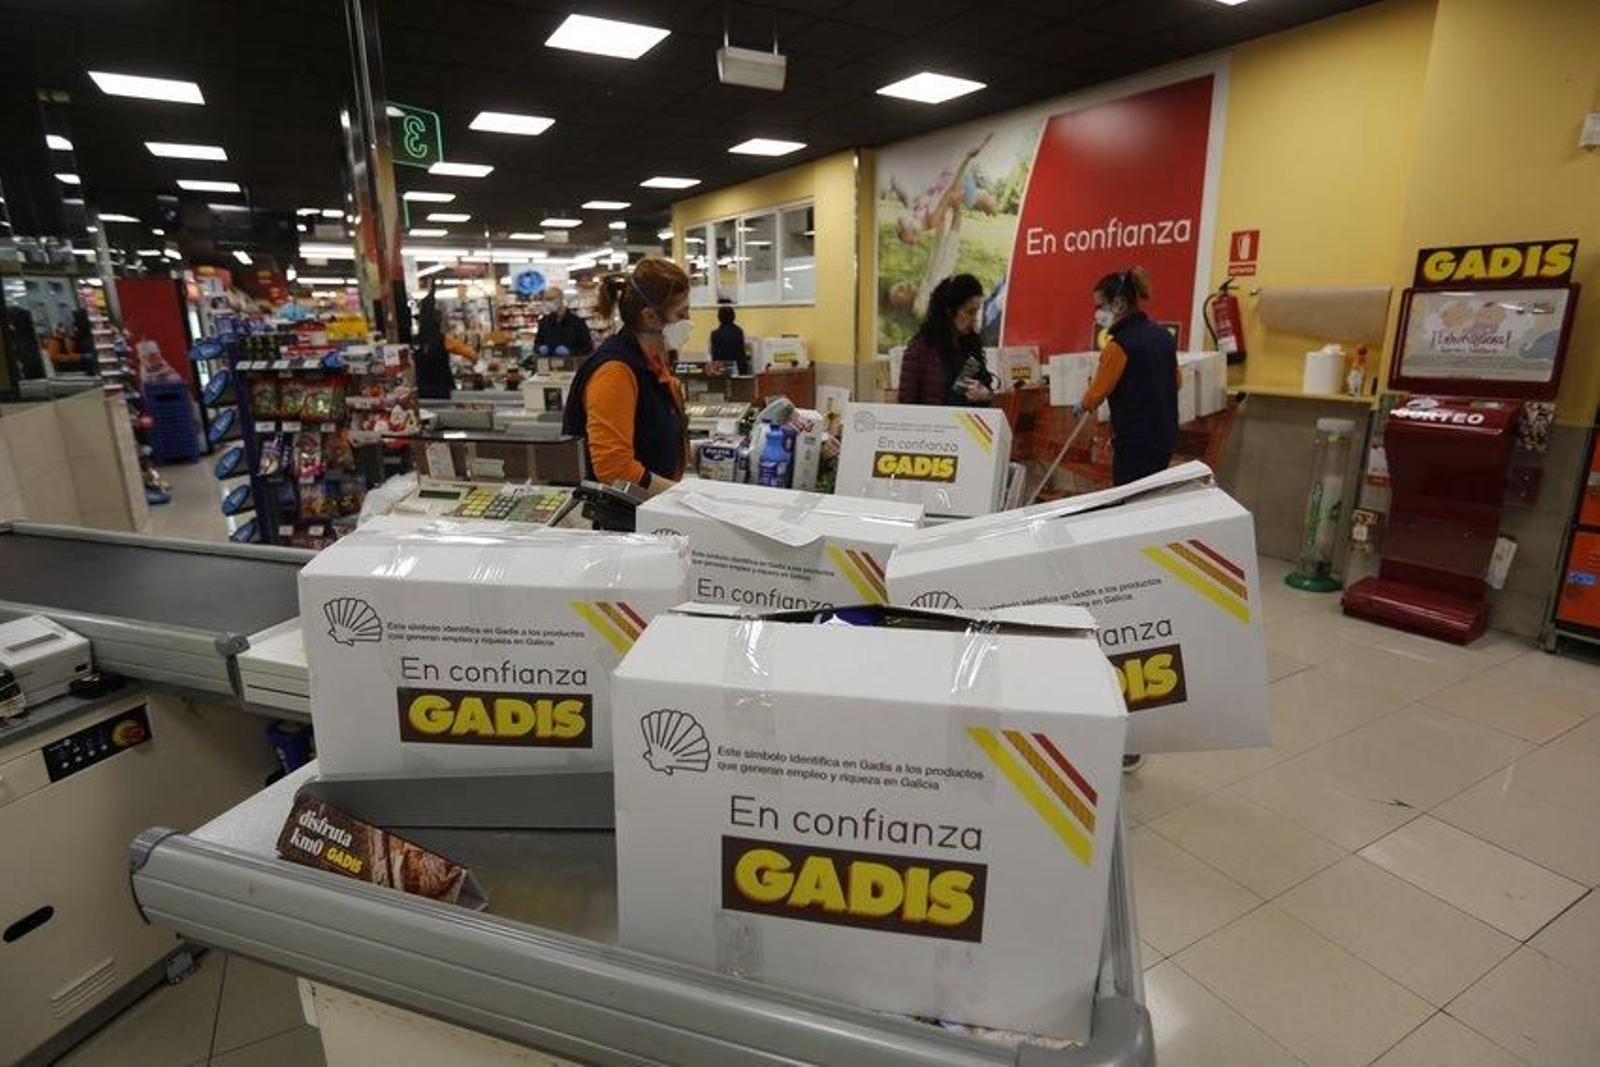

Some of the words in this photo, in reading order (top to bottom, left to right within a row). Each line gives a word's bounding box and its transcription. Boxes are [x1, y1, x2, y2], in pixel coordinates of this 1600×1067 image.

[1026, 227, 1057, 255] En
[1064, 217, 1192, 252] confianza
[1424, 243, 1575, 282] GADIS
[878, 437, 895, 449] En
[898, 439, 959, 452] confianza
[877, 454, 955, 478] GADIS
[697, 578, 725, 599] En
[401, 656, 440, 681] En
[449, 660, 588, 686] confianza
[408, 694, 587, 740] GADIS
[717, 761, 738, 771] que
[740, 763, 784, 776] generan
[786, 769, 828, 781] empleo
[829, 773, 837, 783] y
[839, 772, 881, 786] riqueza
[883, 778, 898, 786] en
[900, 777, 940, 790] Galicia
[718, 746, 741, 758] Este
[789, 754, 840, 768] identifica
[842, 759, 857, 769] en
[859, 759, 892, 772] Gadis
[905, 764, 922, 775] los
[925, 766, 985, 780] productos
[298, 809, 352, 848] disfruta
[731, 794, 779, 830] En
[793, 807, 982, 851] confianza
[290, 827, 324, 856] km0
[326, 847, 364, 874] GADIS
[734, 848, 975, 926] GADIS
